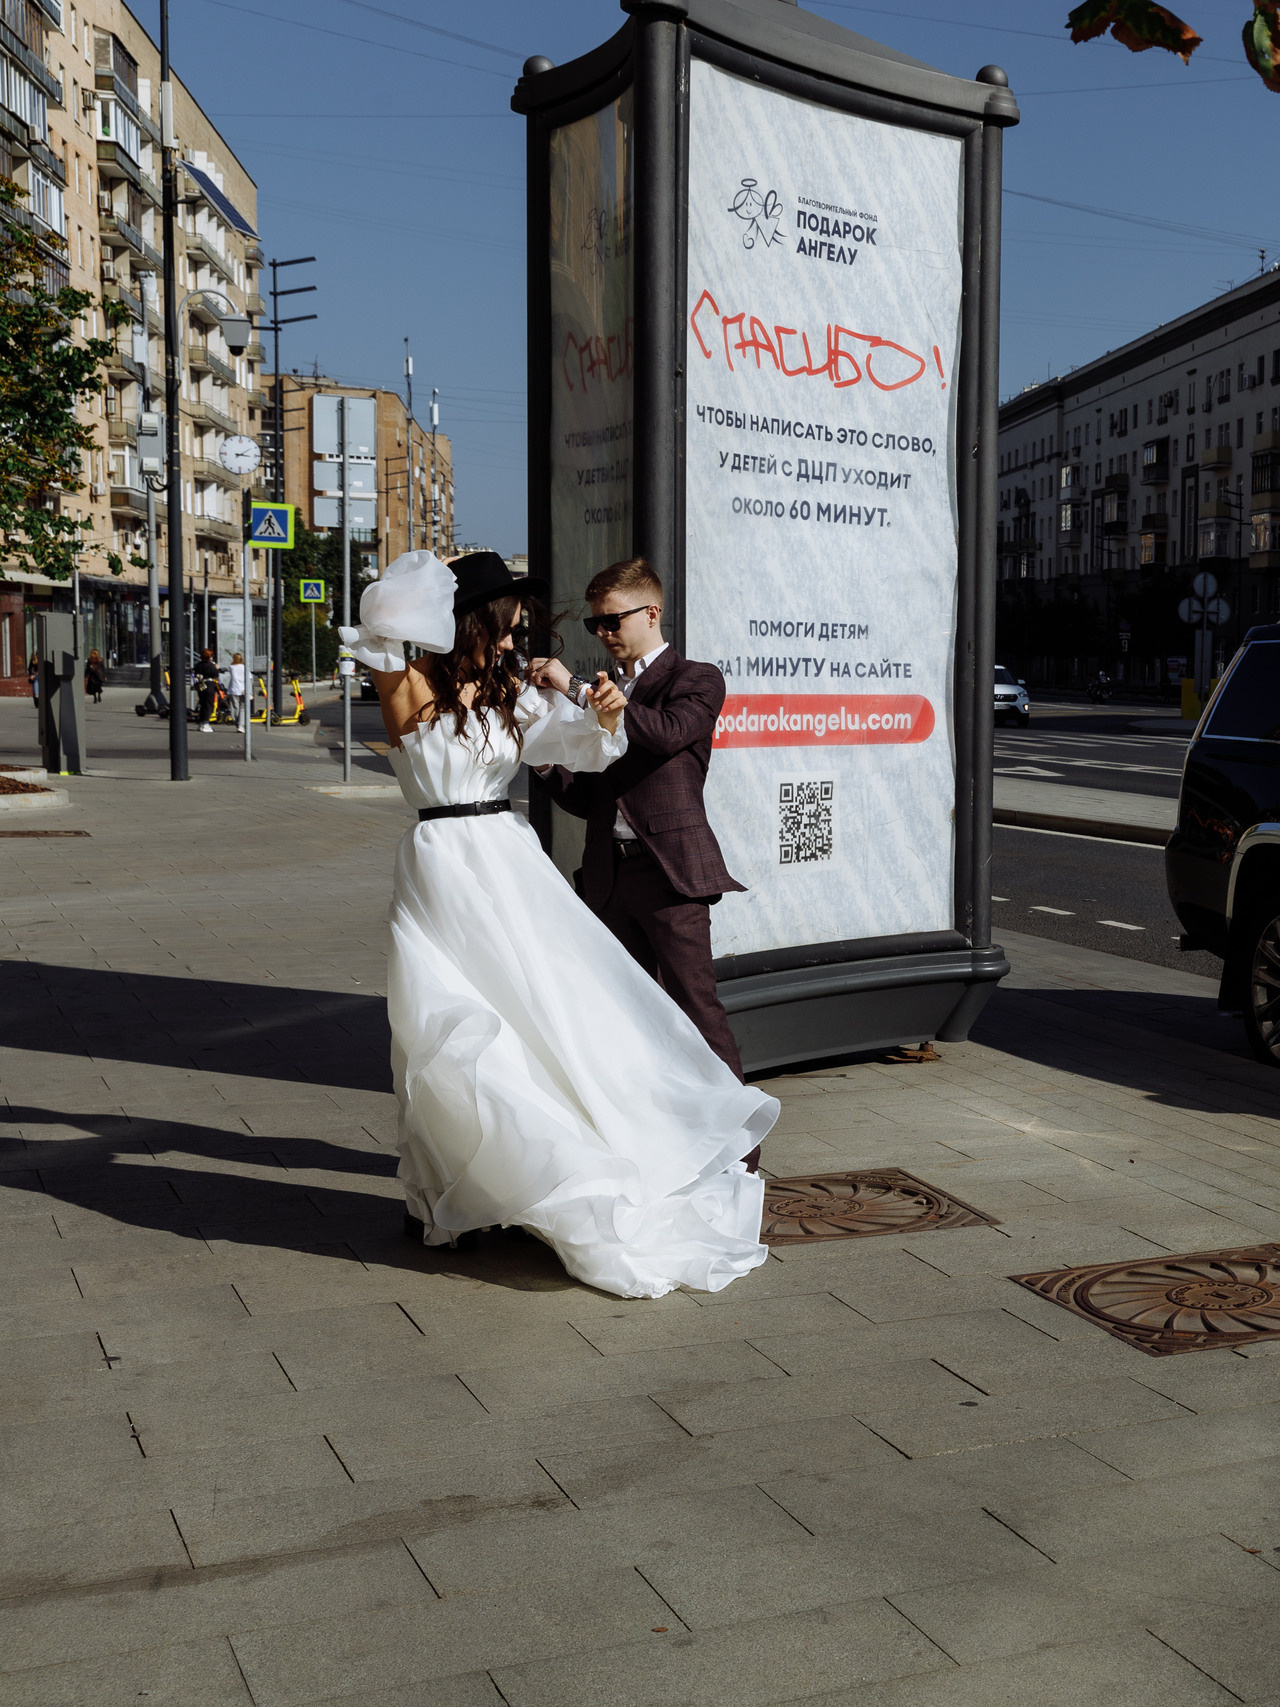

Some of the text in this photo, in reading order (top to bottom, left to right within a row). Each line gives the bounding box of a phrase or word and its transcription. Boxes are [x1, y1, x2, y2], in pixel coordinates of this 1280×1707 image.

[798, 196, 878, 223] БЛАГОТВОРИТЕЛЬНЫЙ ФОНД
[797, 209, 877, 246] ПОДАРОК
[796, 236, 858, 266] АНГЕЛУ
[695, 404, 937, 457] ЧТОБЫ НАПИСАТЬ ЭТО СЛОВО,
[719, 451, 912, 491] У ДЕТЕЙ С ДЦП УХОДИТ
[731, 496, 892, 527] ОКОЛО 60 МИНУТ.
[749, 620, 869, 642] ПОМОГИ ДЕТЯМ
[717, 656, 912, 679] ЗА 1 МИНУТУ НА САЙТЕ
[715, 706, 912, 739] podarokangelu.com
